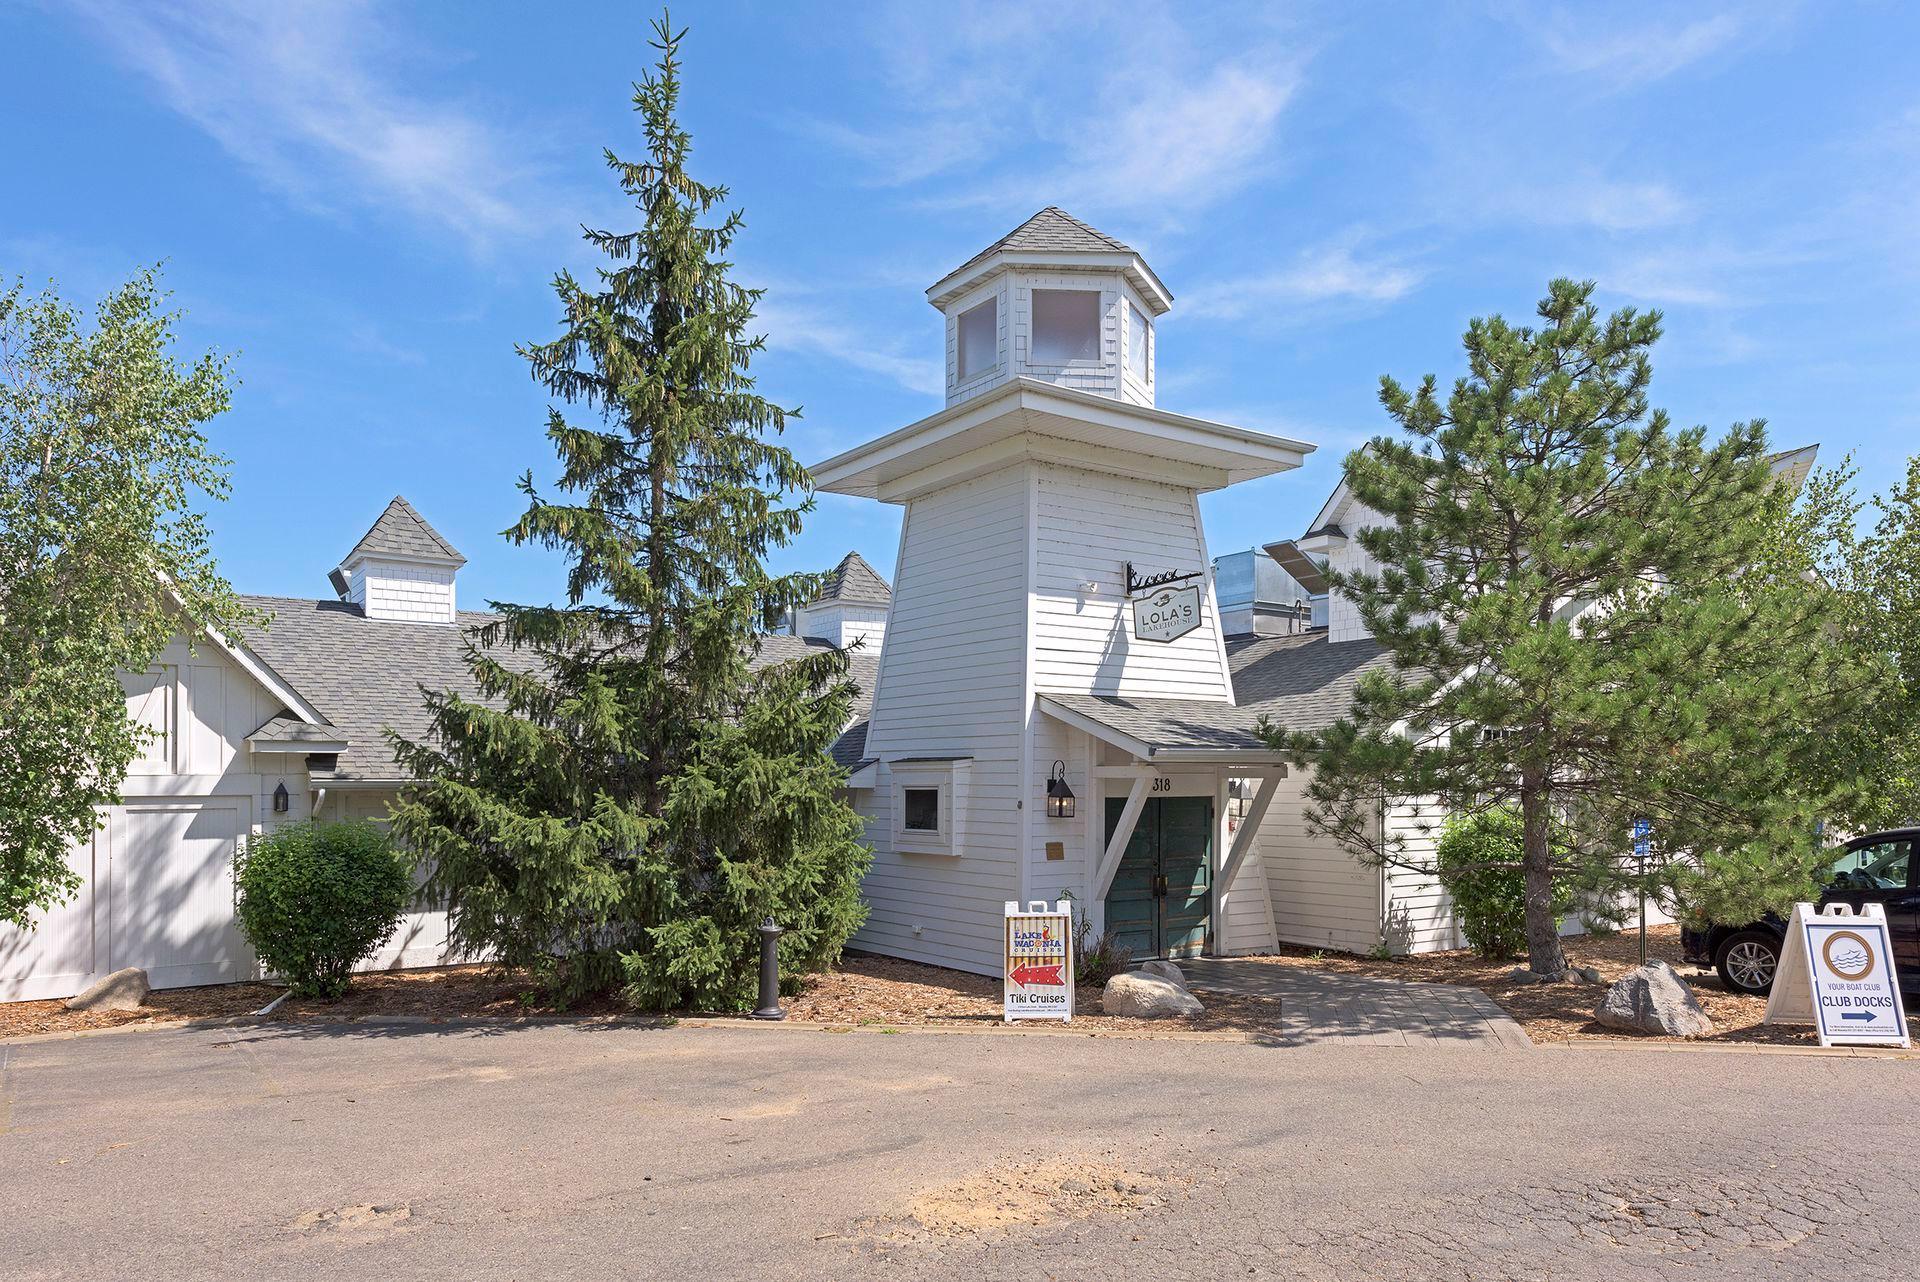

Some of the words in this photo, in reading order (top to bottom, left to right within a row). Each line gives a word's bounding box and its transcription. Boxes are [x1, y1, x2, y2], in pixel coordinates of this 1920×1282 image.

[1142, 605, 1192, 626] LOLA'S
[1142, 617, 1193, 633] LAKEHOUSE
[1153, 777, 1171, 791] 318
[1014, 932, 1042, 940] LAKE
[1014, 939, 1062, 948] WACONIA
[1828, 983, 1845, 991] YOUR
[1846, 983, 1863, 991] BOAT
[1864, 983, 1881, 991] CLUB
[1009, 993, 1027, 1004] Tiki
[1029, 993, 1066, 1004] Cruises
[1822, 996, 1852, 1007] CLUB
[1854, 996, 1892, 1008] DOCKS
